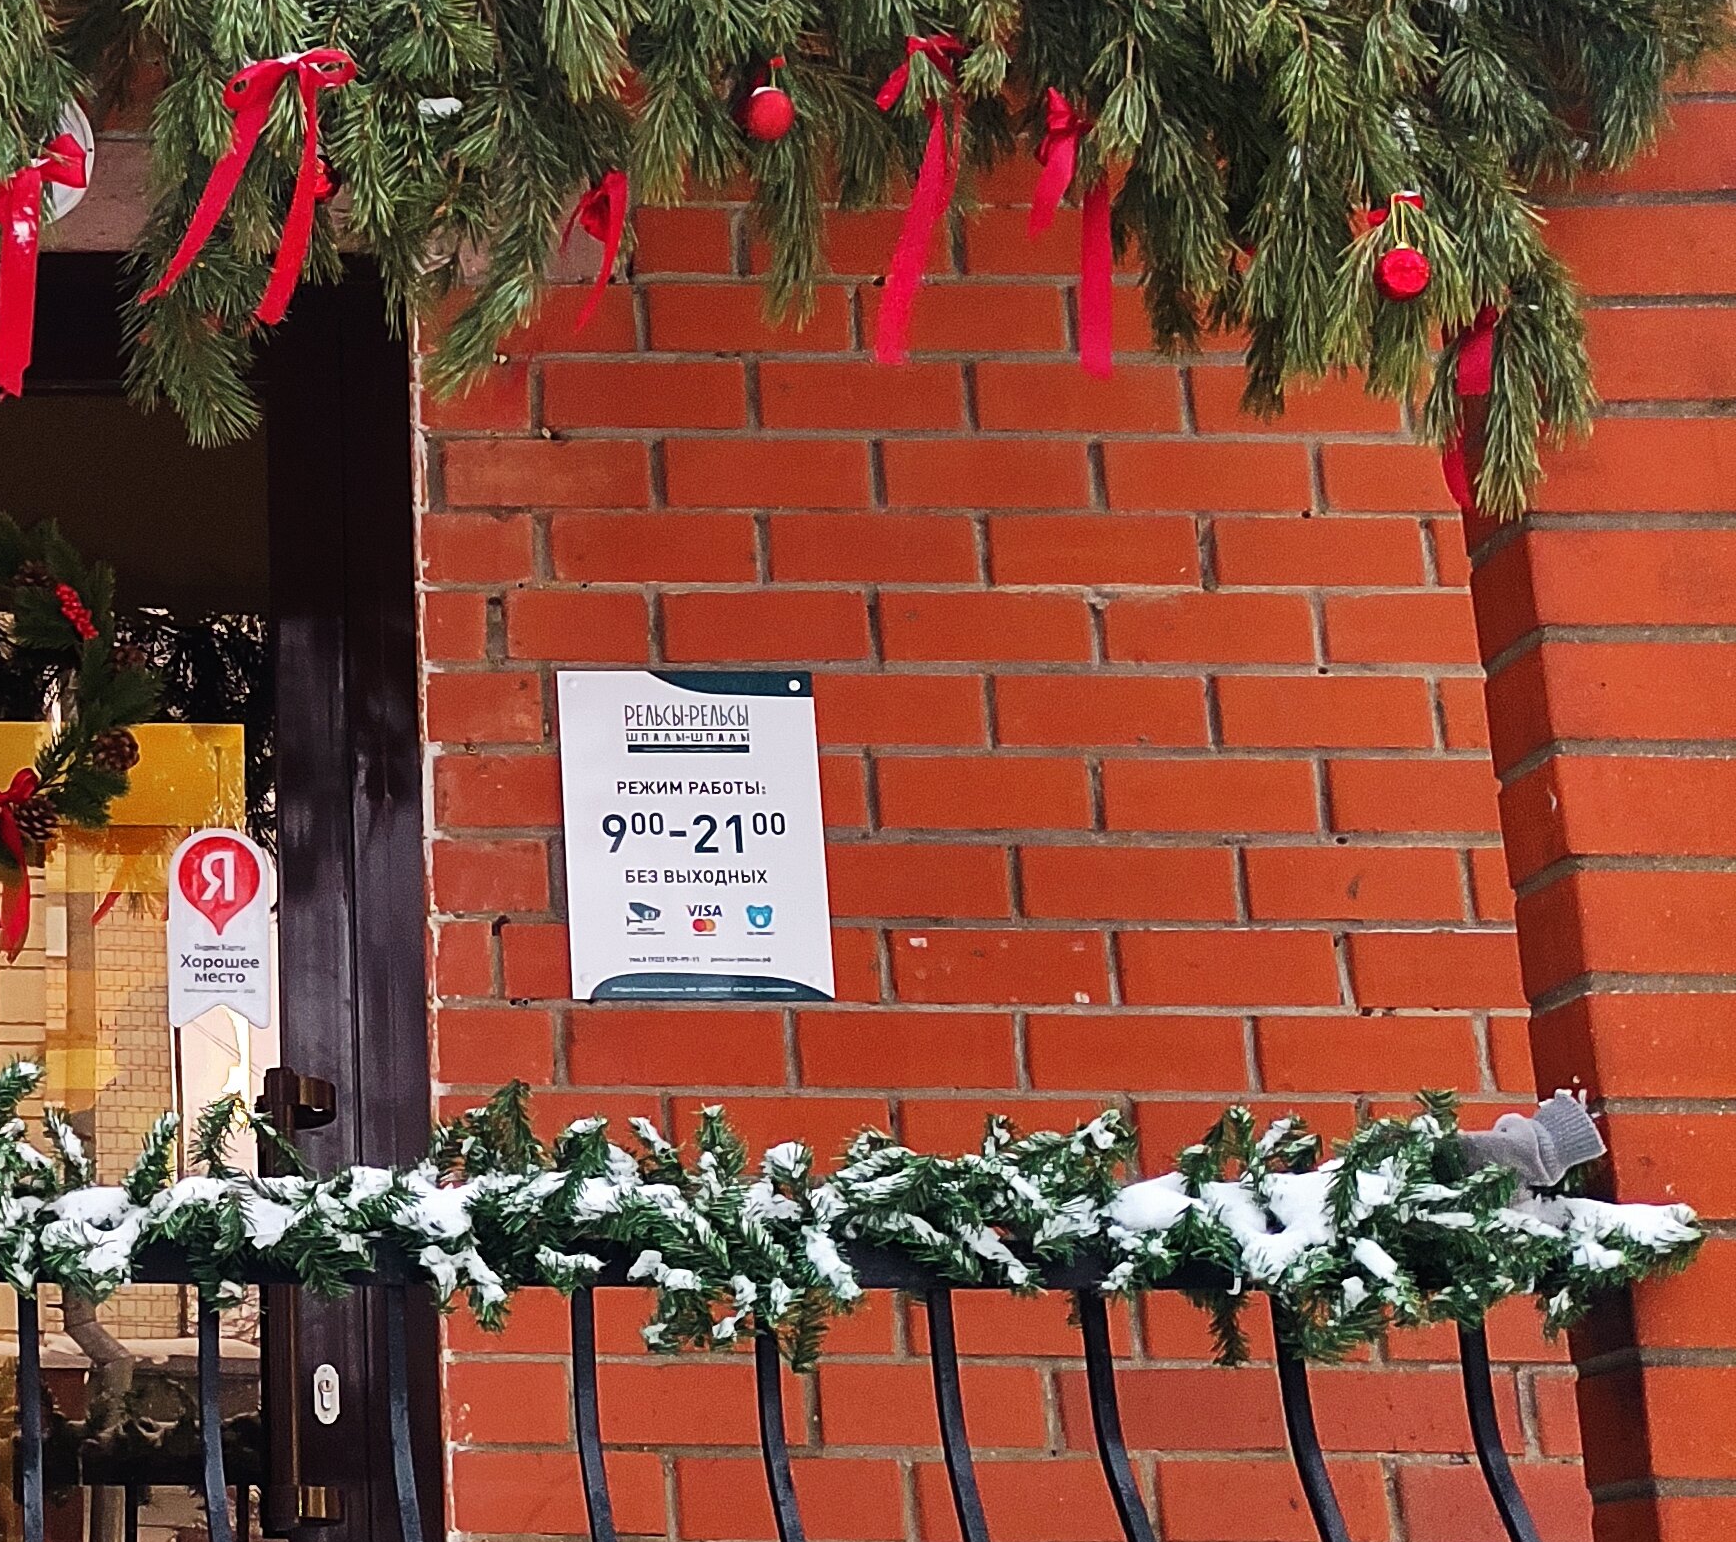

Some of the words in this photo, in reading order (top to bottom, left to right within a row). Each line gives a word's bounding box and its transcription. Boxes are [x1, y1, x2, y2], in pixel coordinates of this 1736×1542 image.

[624, 704, 749, 727] РЕЛЬСЫ-РЕЛЬСЫ
[625, 732, 751, 742] ШПАЛЫ-ШПАЛЫ
[616, 781, 683, 795] РЕЖИМ
[688, 781, 767, 795] РАБОТЫ:
[200, 850, 236, 902] Я
[625, 869, 658, 884] БЕЗ
[663, 870, 768, 886] ВЫХОДНЫХ
[686, 904, 723, 917] VISA
[180, 954, 260, 971] Хорошее
[194, 972, 246, 983] место
